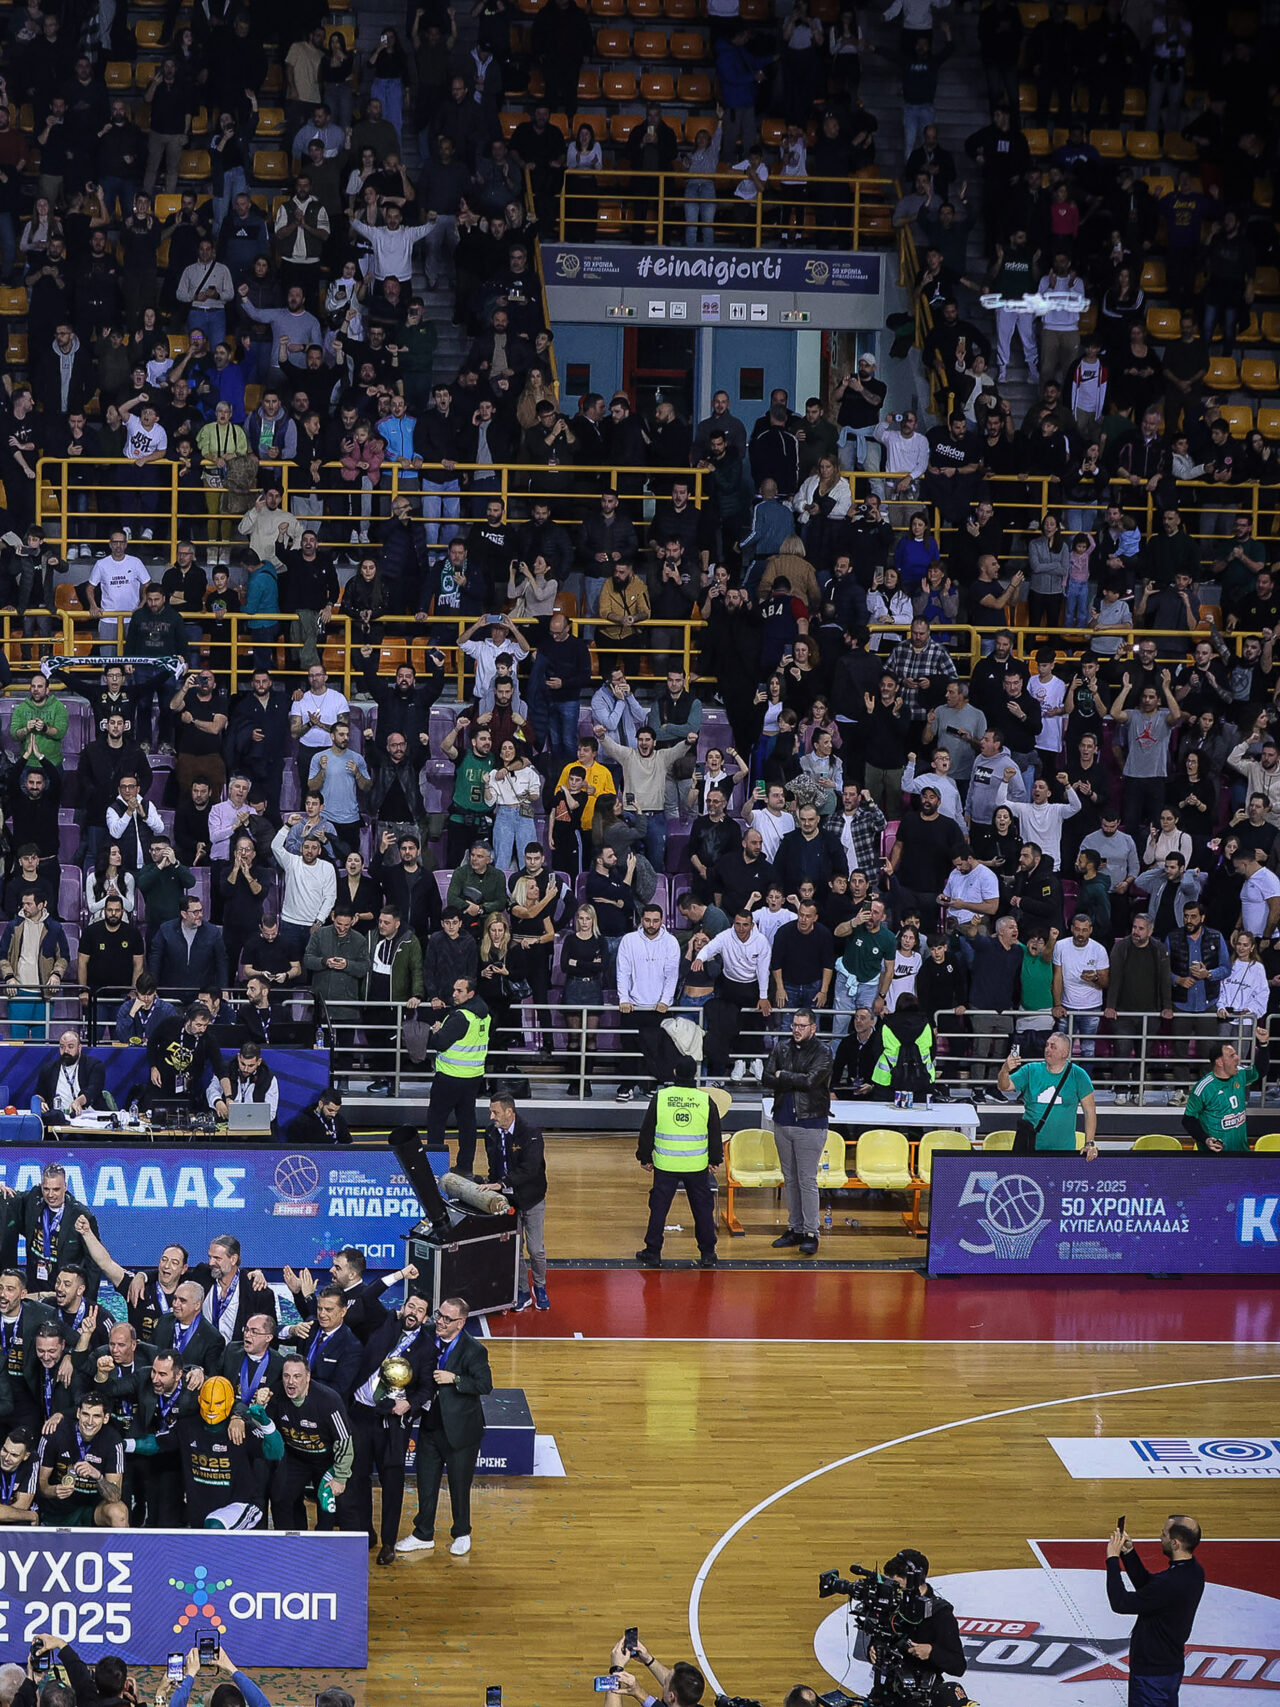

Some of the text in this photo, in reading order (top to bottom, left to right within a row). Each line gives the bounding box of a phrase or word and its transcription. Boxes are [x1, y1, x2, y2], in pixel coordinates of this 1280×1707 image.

[637, 255, 782, 285] #einaigiorti
[133, 431, 152, 445] JUST
[937, 443, 965, 458] adidas
[895, 964, 914, 974] NIKE
[675, 1113, 689, 1122] 025
[1061, 1197, 1166, 1217] 50 ΧΡΟΝΙΑ
[1059, 1219, 1190, 1234] ΚΥΠΕΛΛΟ ΕΛΛΑΔΑΣ
[191, 1453, 231, 1468] 2025
[24, 1600, 132, 1644] 2025
